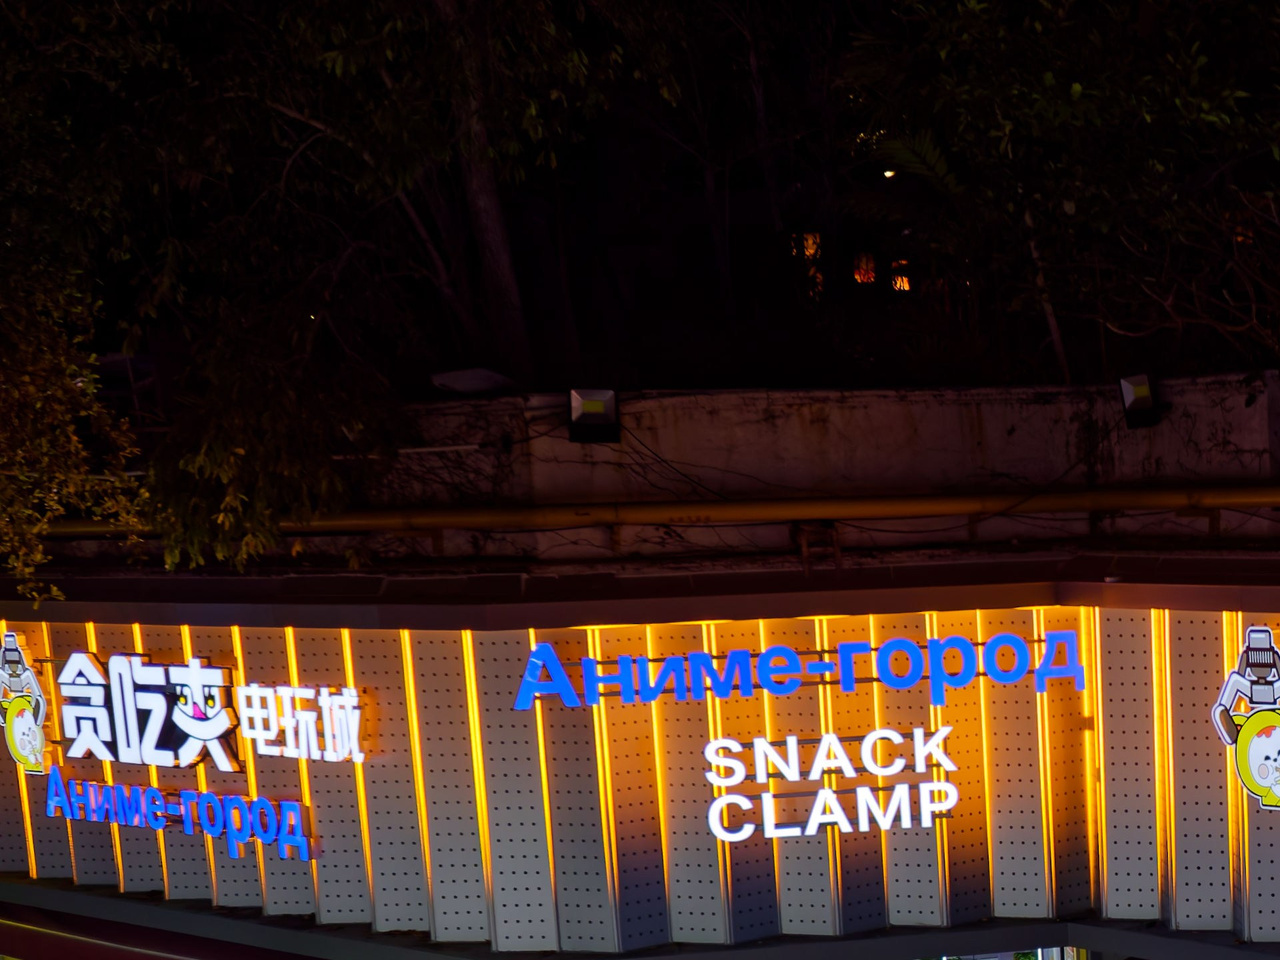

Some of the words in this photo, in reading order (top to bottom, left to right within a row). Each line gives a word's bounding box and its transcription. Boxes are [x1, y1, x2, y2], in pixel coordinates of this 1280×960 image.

[514, 630, 1085, 710] Аниме-город
[704, 726, 958, 787] SNACK
[46, 765, 312, 861] Аниме-город
[707, 780, 960, 842] CLAMP
